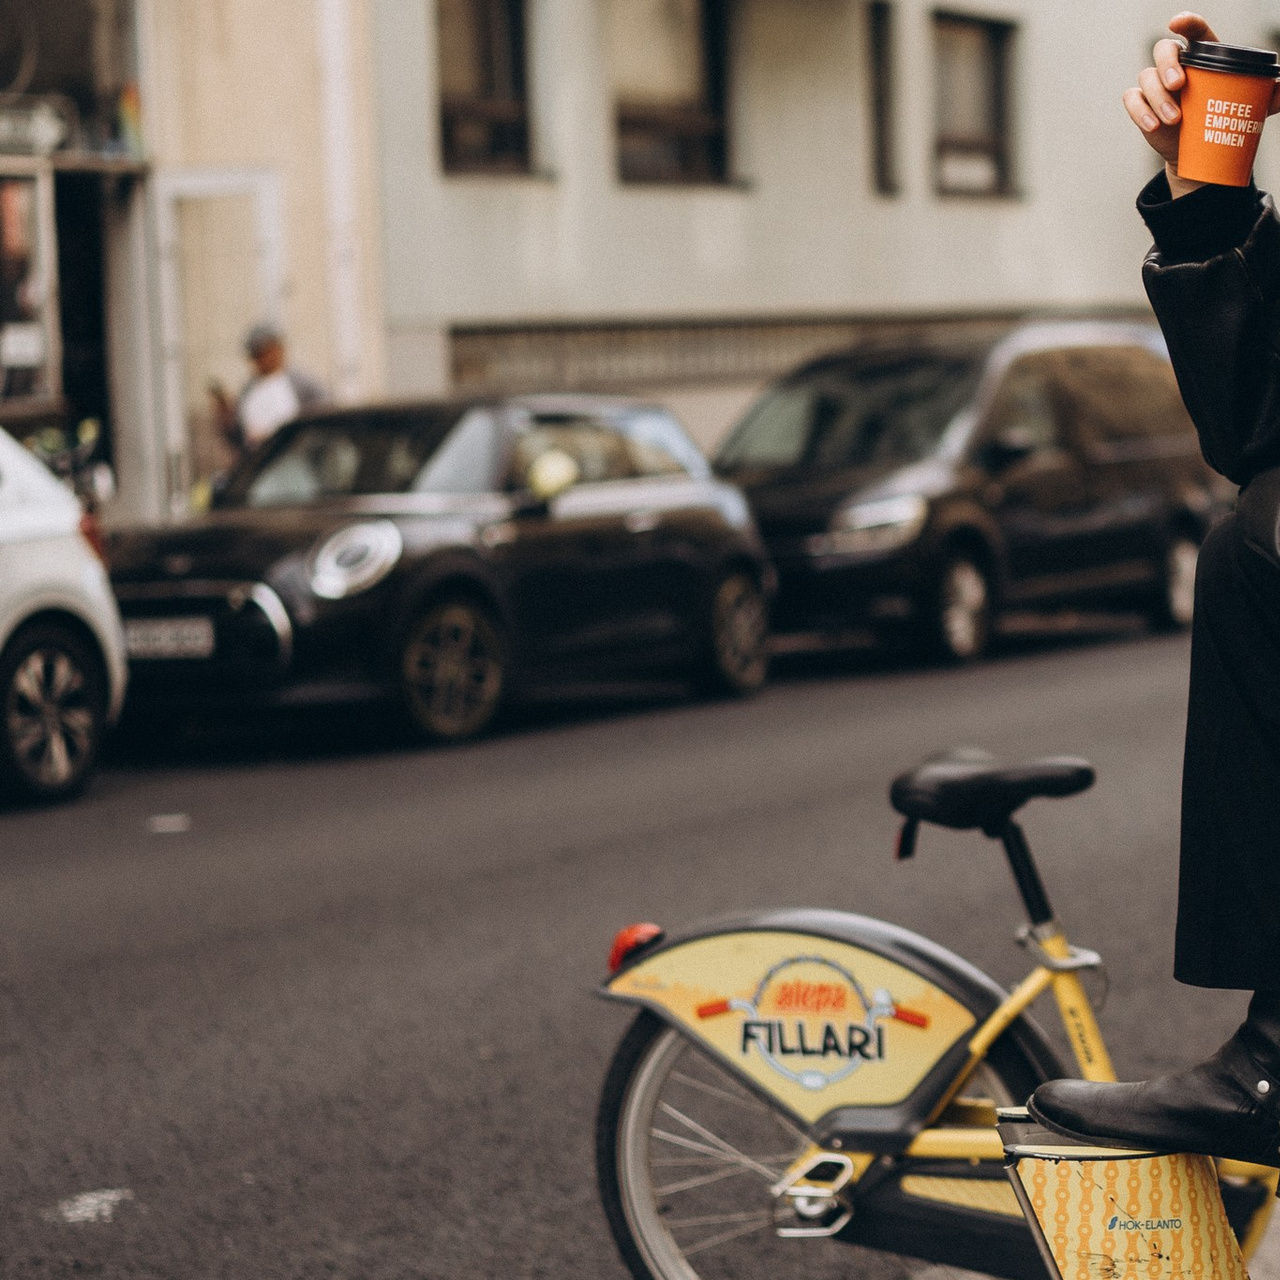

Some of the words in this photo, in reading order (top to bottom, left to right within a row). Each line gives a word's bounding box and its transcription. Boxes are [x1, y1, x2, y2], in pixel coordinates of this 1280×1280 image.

[1207, 99, 1252, 117] COFFEE
[1204, 129, 1245, 147] WOMEN
[742, 1022, 883, 1060] FILLARI
[1119, 1219, 1182, 1231] HOK-ELANTO
